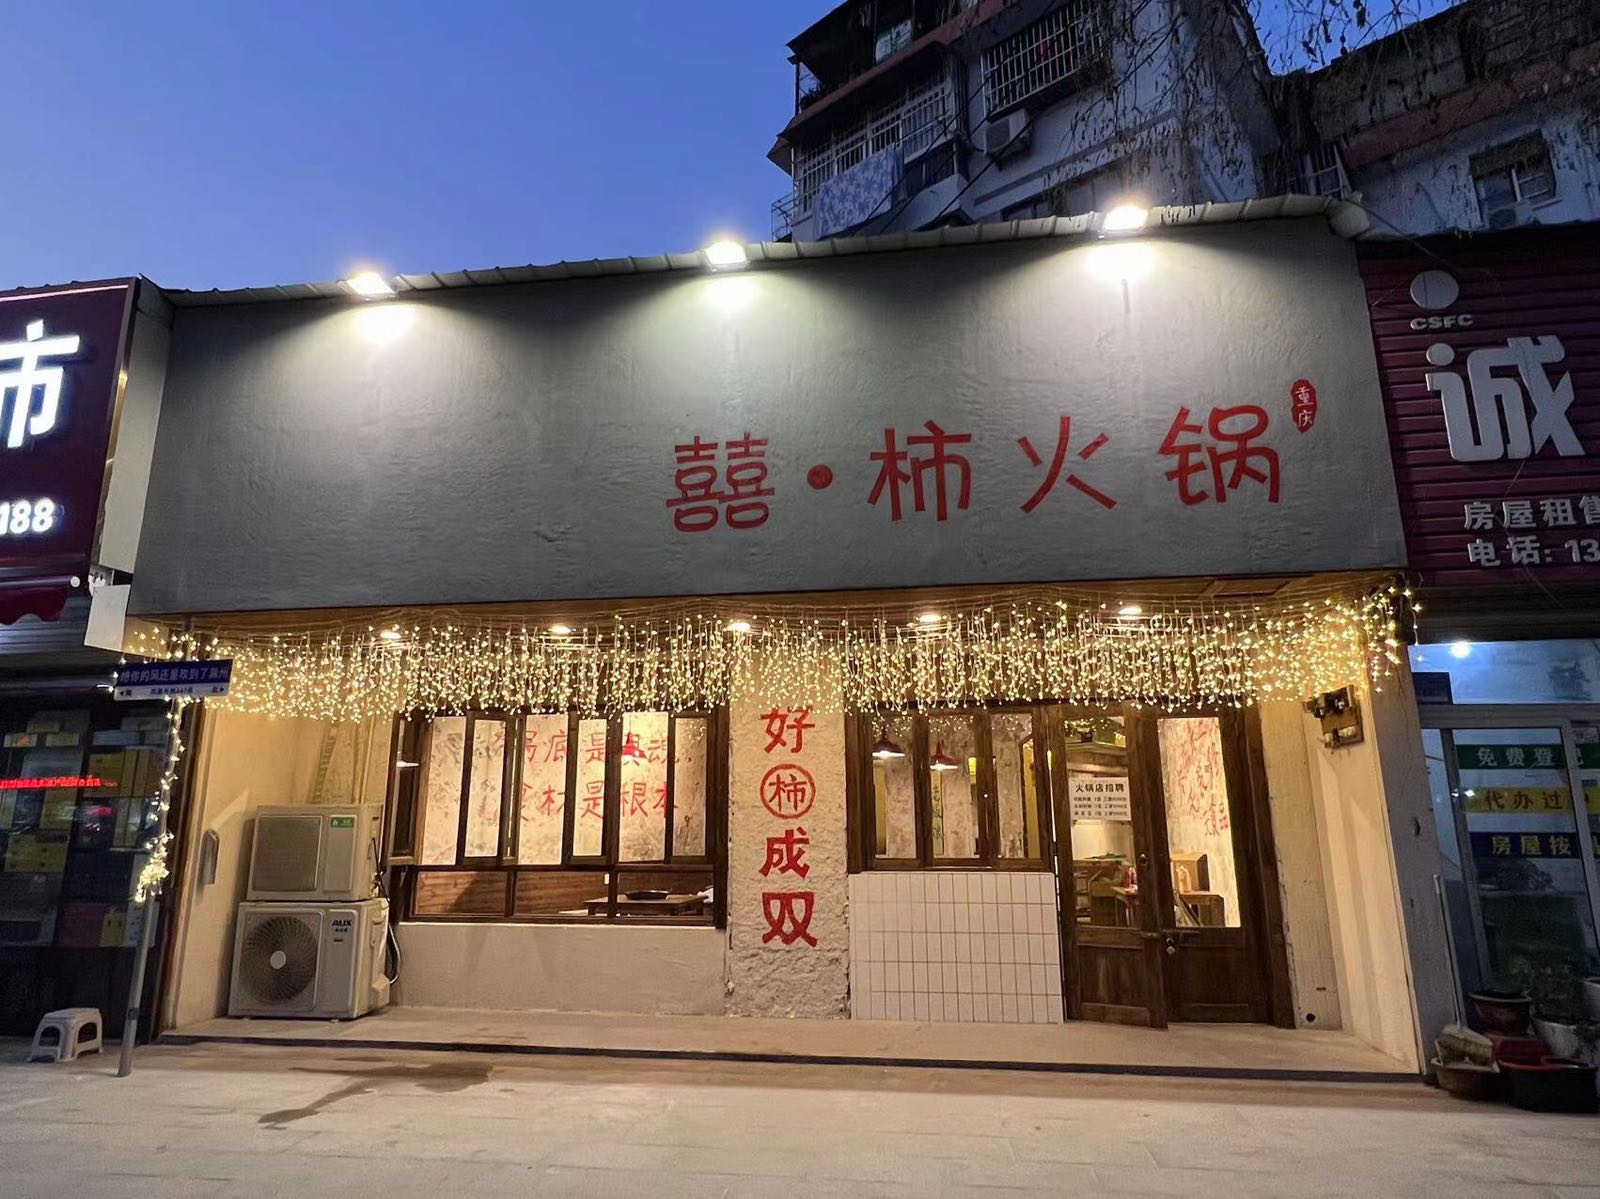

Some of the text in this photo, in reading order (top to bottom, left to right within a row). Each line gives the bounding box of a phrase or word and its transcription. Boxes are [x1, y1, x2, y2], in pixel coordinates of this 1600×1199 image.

[1410, 314, 1474, 330] CSFC
[0, 319, 80, 449] 市
[1295, 384, 1314, 430] 重庆
[1425, 334, 1587, 462] 诚
[1477, 747, 1584, 767] 免费登
[1075, 783, 1124, 793] 火锅店招聘
[1485, 790, 1590, 811] 代办过
[758, 705, 818, 948] 好柿成双
[1491, 835, 1600, 856] 房屋按
[331, 919, 353, 927] AUX
